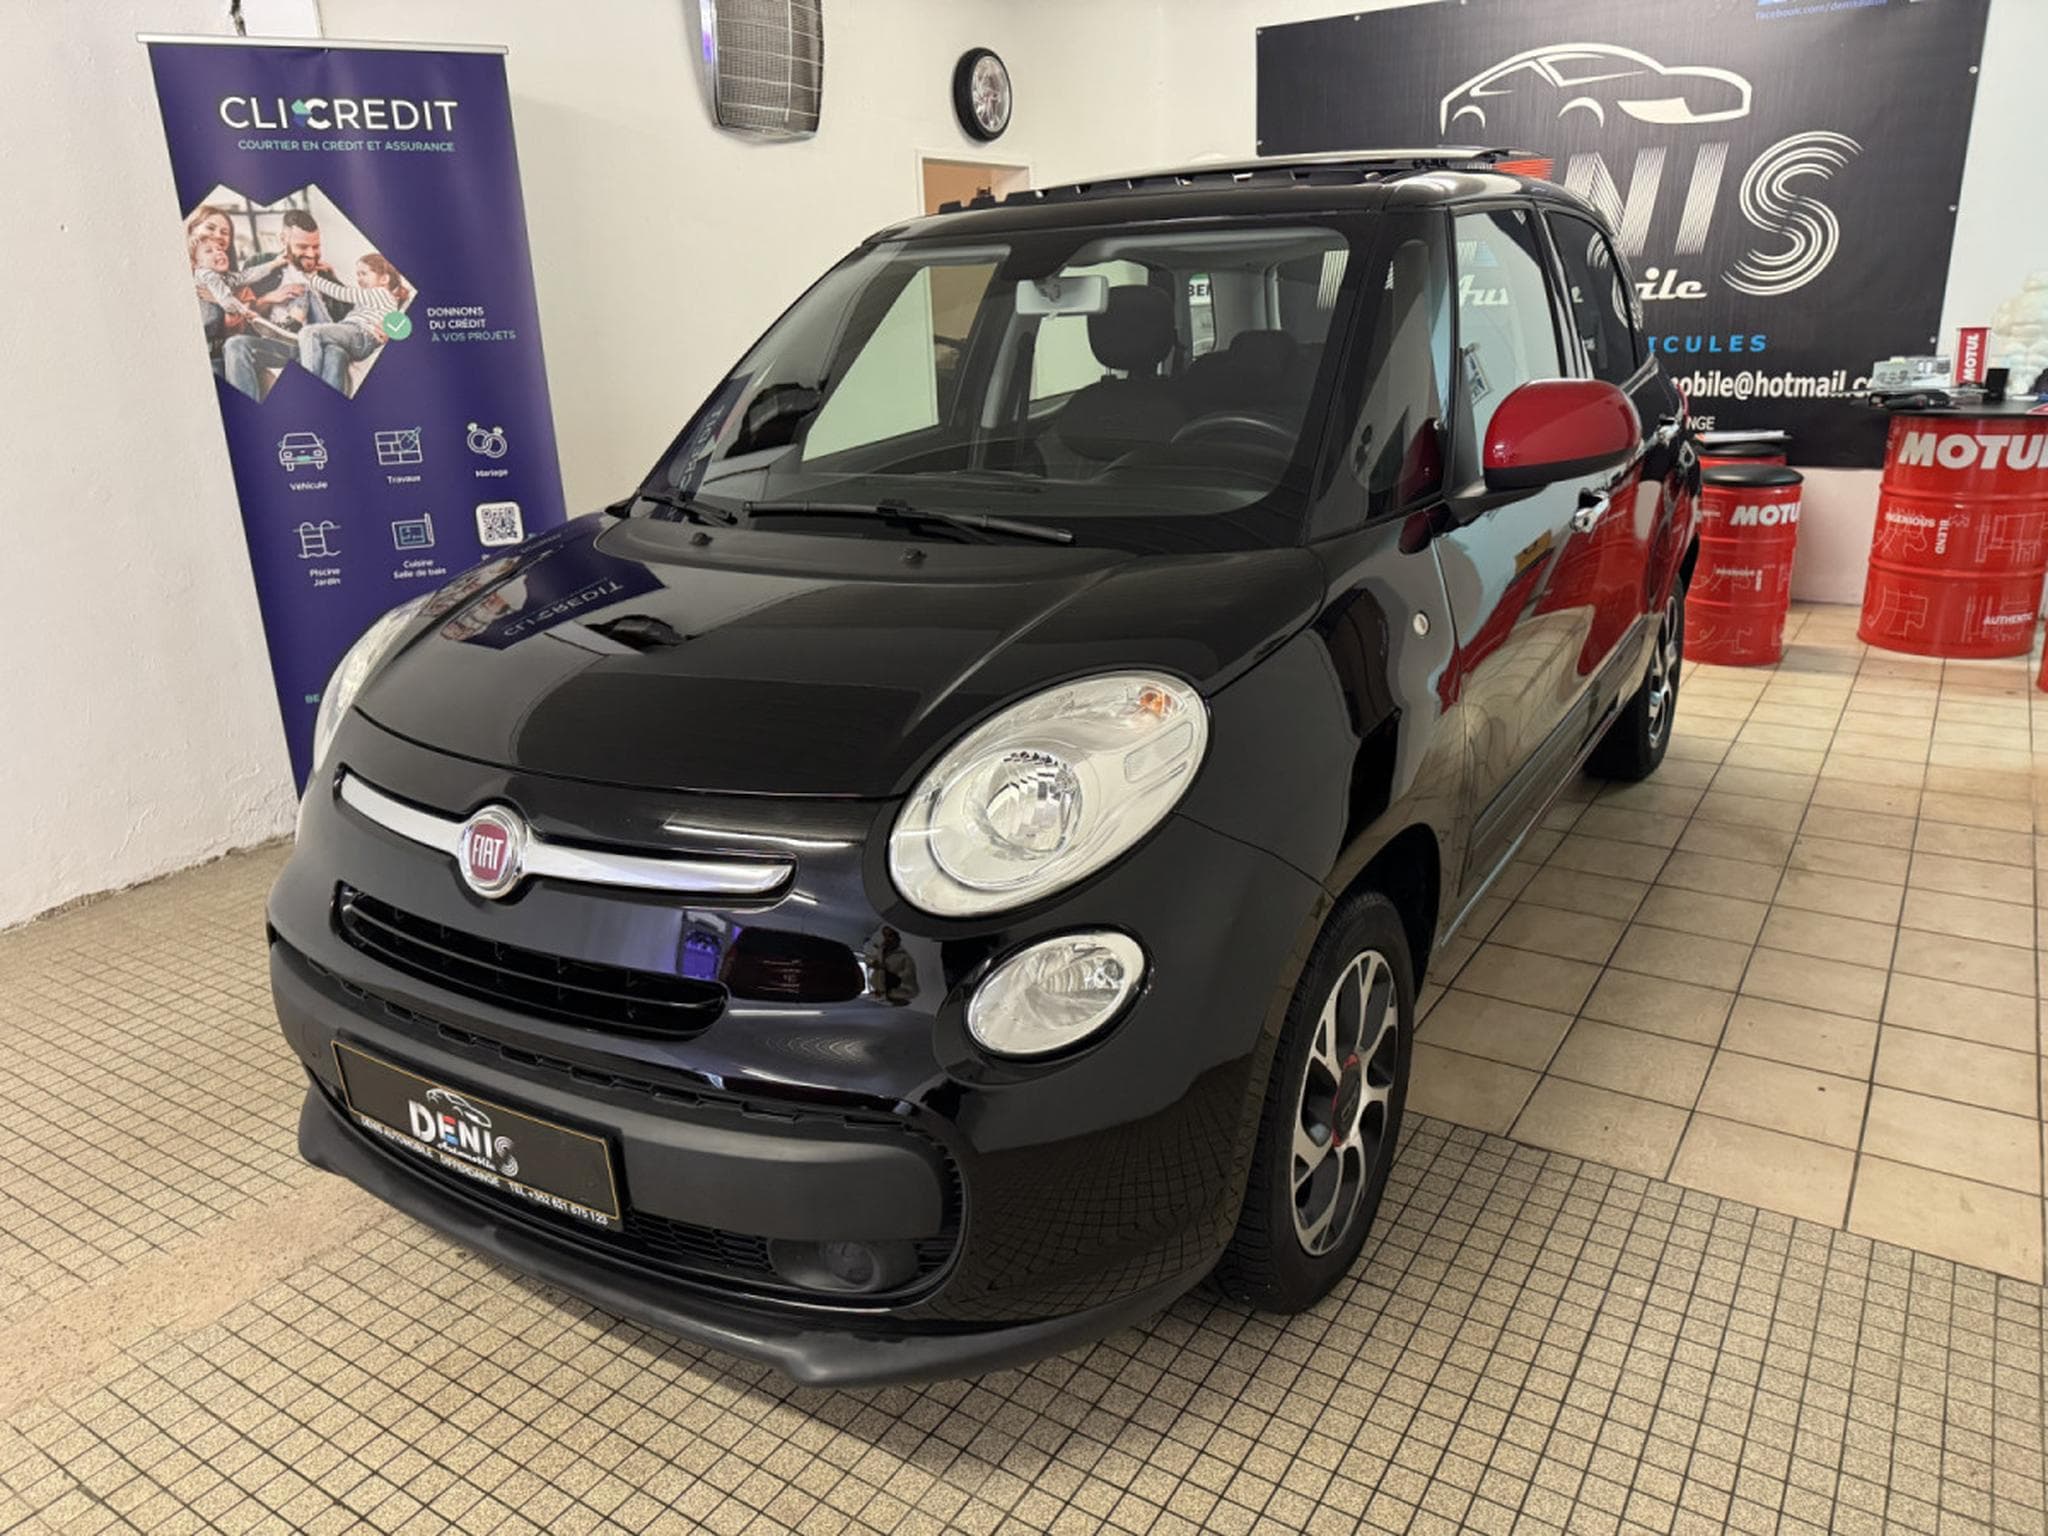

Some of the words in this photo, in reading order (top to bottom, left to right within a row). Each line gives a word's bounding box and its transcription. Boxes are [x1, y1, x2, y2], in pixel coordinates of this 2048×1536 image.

[238, 139, 300, 151] COURTIER
[302, 140, 320, 151] EN
[367, 140, 381, 151] ET
[385, 141, 455, 152] ASSURANCE
[427, 306, 485, 317] DONNONS
[429, 320, 446, 330] DU
[442, 332, 466, 342] VOS
[467, 330, 517, 341] PROJETS
[1648, 334, 1767, 353] ICULES
[1963, 333, 1980, 382] MOTUL
[472, 834, 505, 871] FIAT
[408, 1099, 519, 1178] DENIS
